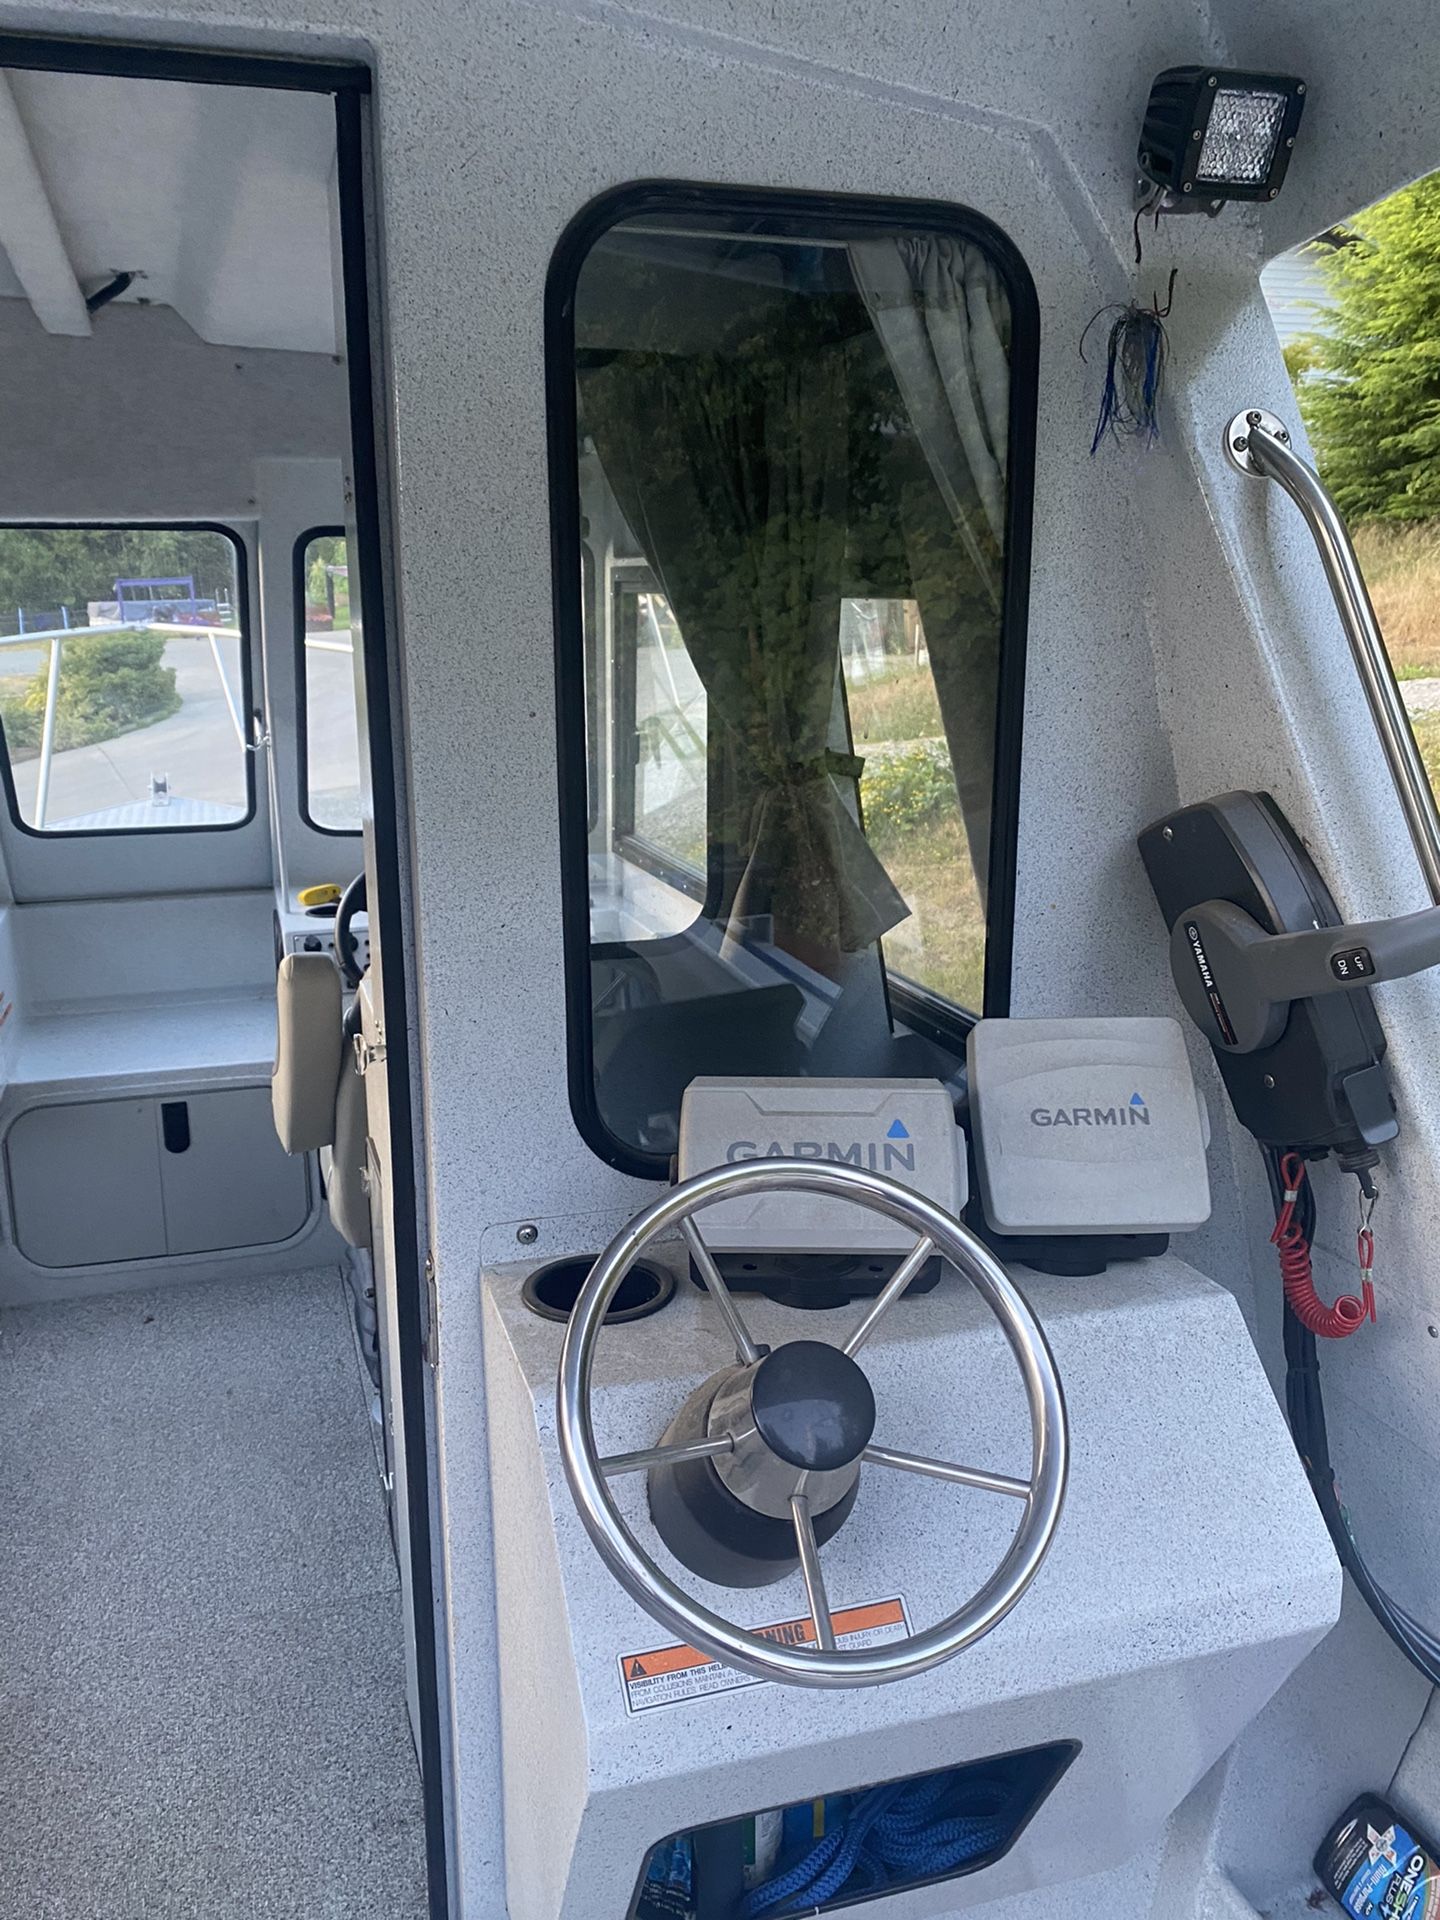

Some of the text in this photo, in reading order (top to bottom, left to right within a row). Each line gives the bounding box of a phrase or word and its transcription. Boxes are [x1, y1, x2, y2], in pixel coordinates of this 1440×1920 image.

[1193, 940, 1213, 987] YAMAHA
[1337, 959, 1349, 975] DN
[1354, 956, 1364, 970] UP
[1030, 1106, 1150, 1127] GARMIN
[757, 1623, 806, 1645] NING
[849, 1631, 872, 1642] INJURY
[873, 1628, 884, 1637] OR
[629, 1676, 665, 1690] VISIBILITY
[667, 1671, 688, 1681] FROM
[690, 1666, 706, 1677] THIS
[631, 1688, 652, 1698] FROM
[653, 1679, 694, 1694] COLLISIONS
[632, 1691, 672, 1706] NAVIGATION
[1389, 1855, 1424, 1920] ONESH
